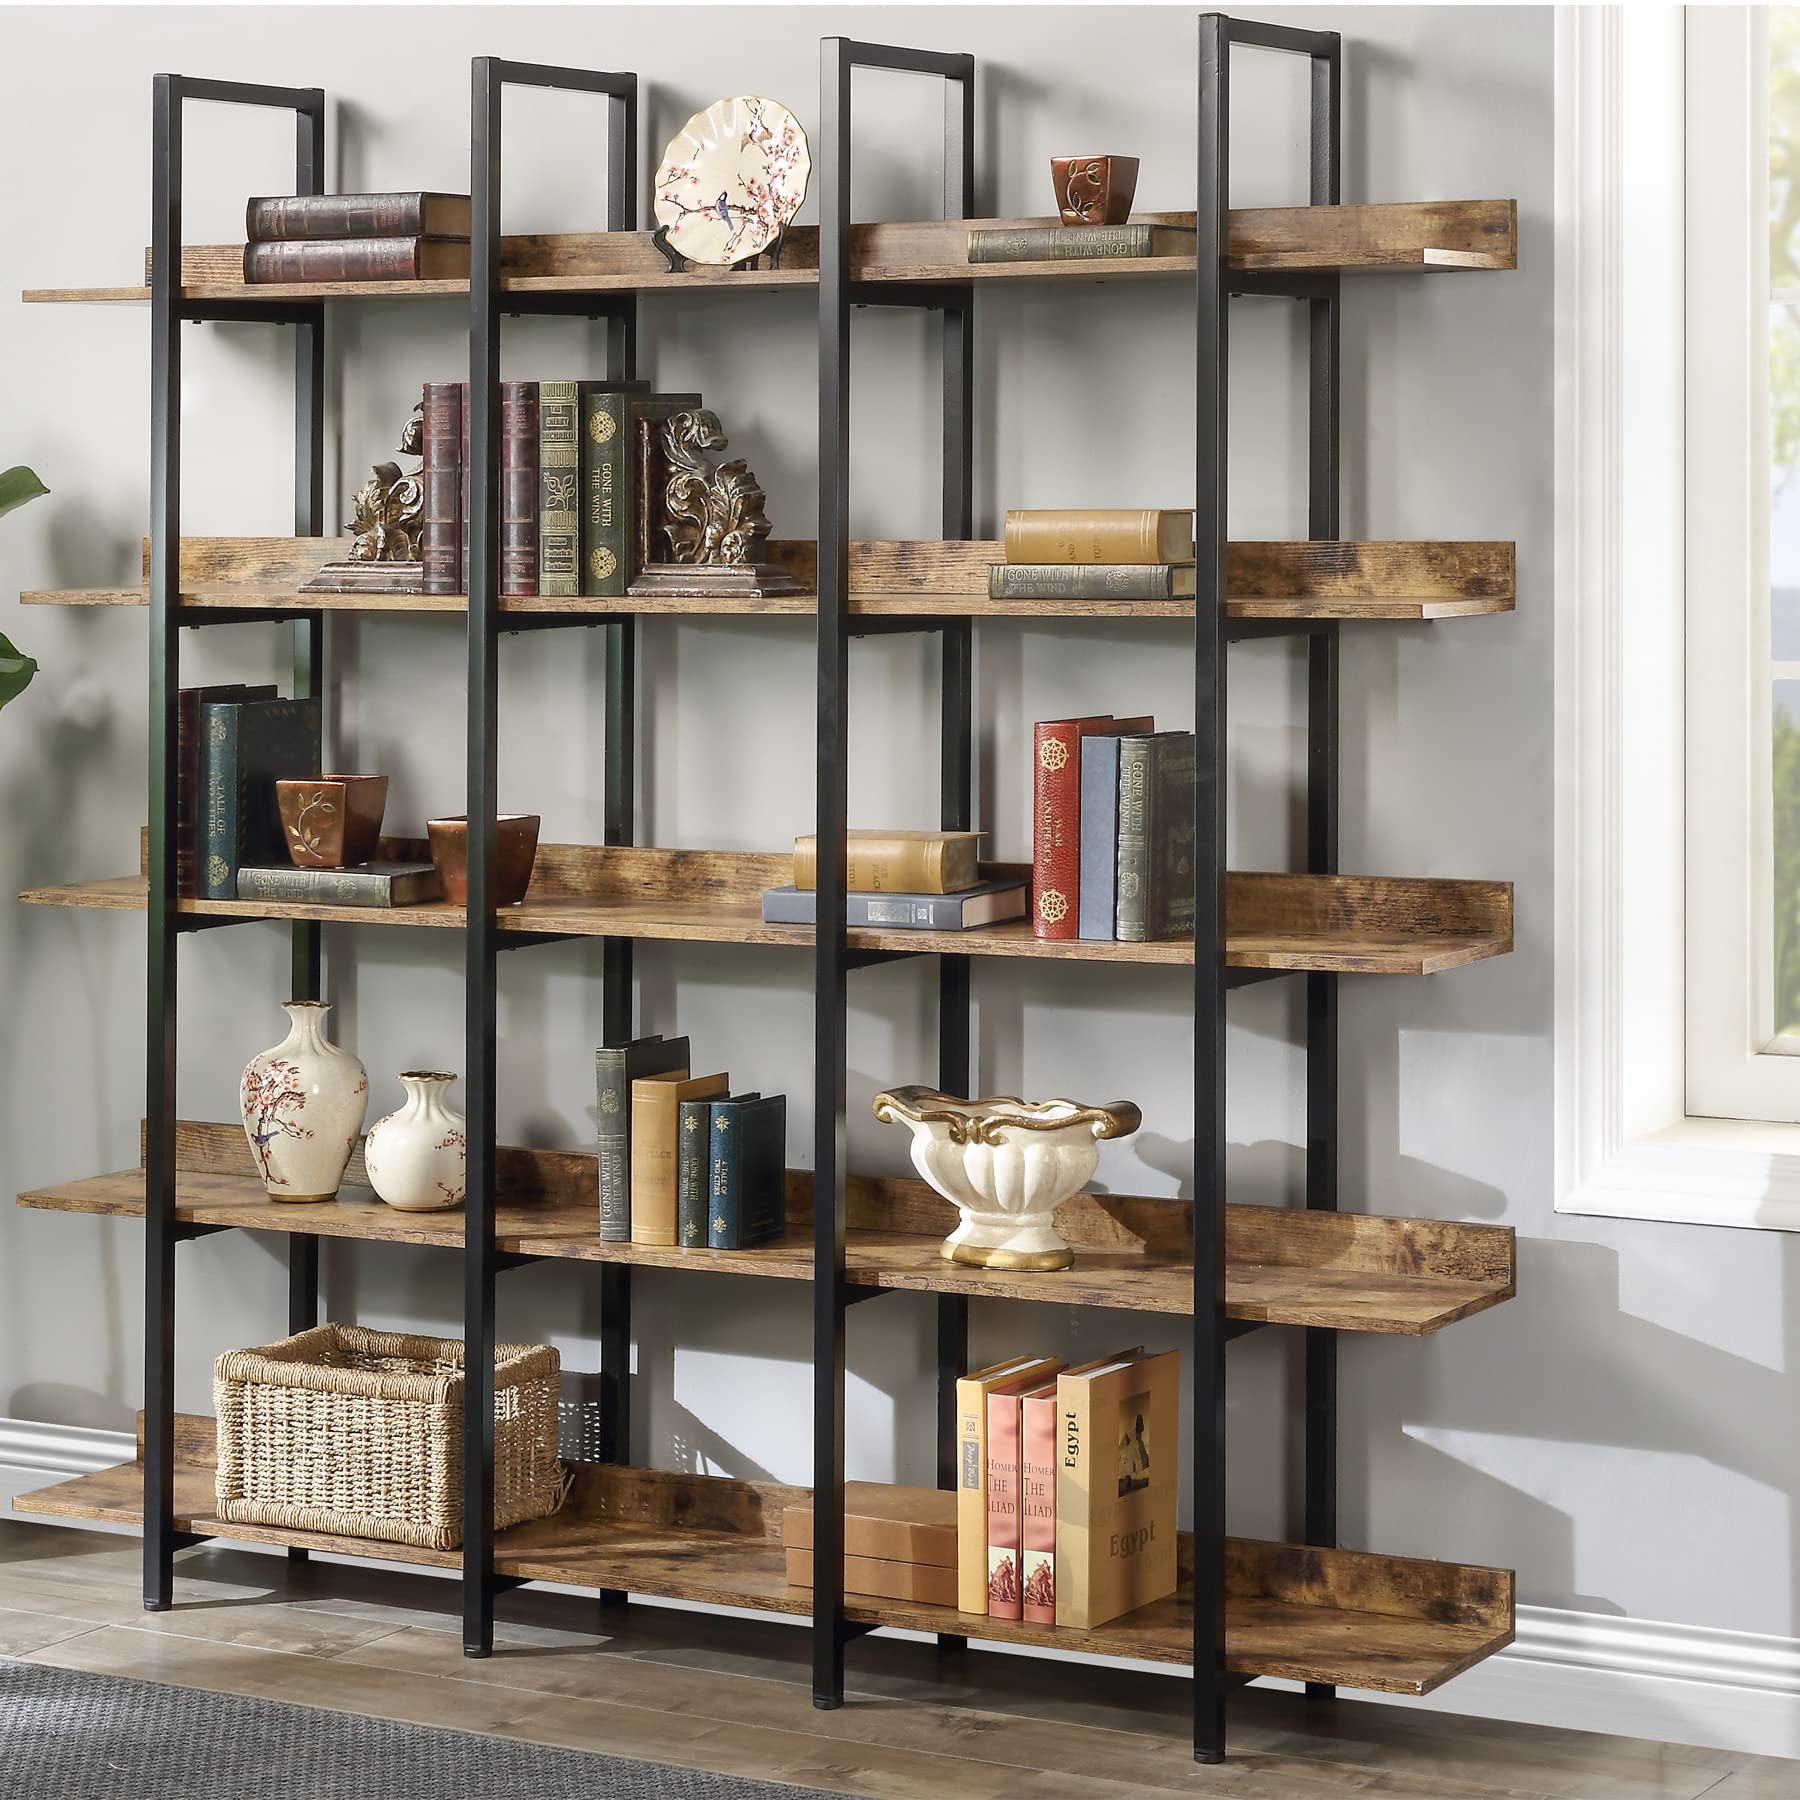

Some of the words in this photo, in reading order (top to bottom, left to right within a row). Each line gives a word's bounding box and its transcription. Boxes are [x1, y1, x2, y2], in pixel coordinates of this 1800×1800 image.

[1067, 232, 1097, 243] WIND
[1101, 231, 1123, 242] THE
[1064, 244, 1093, 257] WITH
[1096, 243, 1127, 256] GONE
[592, 467, 600, 490] THE
[602, 463, 613, 494] GONE
[591, 494, 601, 524] WIND
[602, 497, 612, 527] WITH
[1007, 569, 1037, 581] GONE
[1040, 569, 1069, 581] WITH
[1011, 583, 1034, 594] THE
[1036, 583, 1066, 593] WIND
[1122, 766, 1131, 791] THE
[1132, 761, 1144, 796] GONE
[217, 786, 226, 814] TALE
[1121, 794, 1130, 827] WIND
[1131, 800, 1143, 832] WITH
[217, 819, 226, 834] OF
[254, 874, 280, 885] GONE
[283, 876, 306, 887] WITH
[601, 1151, 611, 1181] WITH
[612, 1154, 622, 1186] WIND
[682, 1160, 690, 1175] THE
[690, 1158, 699, 1179] GONE
[682, 1178, 690, 1197] WIND
[690, 1181, 699, 1201] WITH
[720, 1186, 728, 1196] OF
[601, 1184, 612, 1217] GONE
[613, 1189, 623, 1214] THE
[1065, 1412, 1079, 1468] Egypt
[987, 1459, 1018, 1472] HOMER
[1024, 1462, 1055, 1476] HOMER
[987, 1473, 1008, 1492] THE
[1024, 1477, 1045, 1496] THE
[987, 1494, 1015, 1514] ILIAD
[1024, 1498, 1053, 1518] ILIAD
[1110, 1520, 1157, 1559] Egypt
